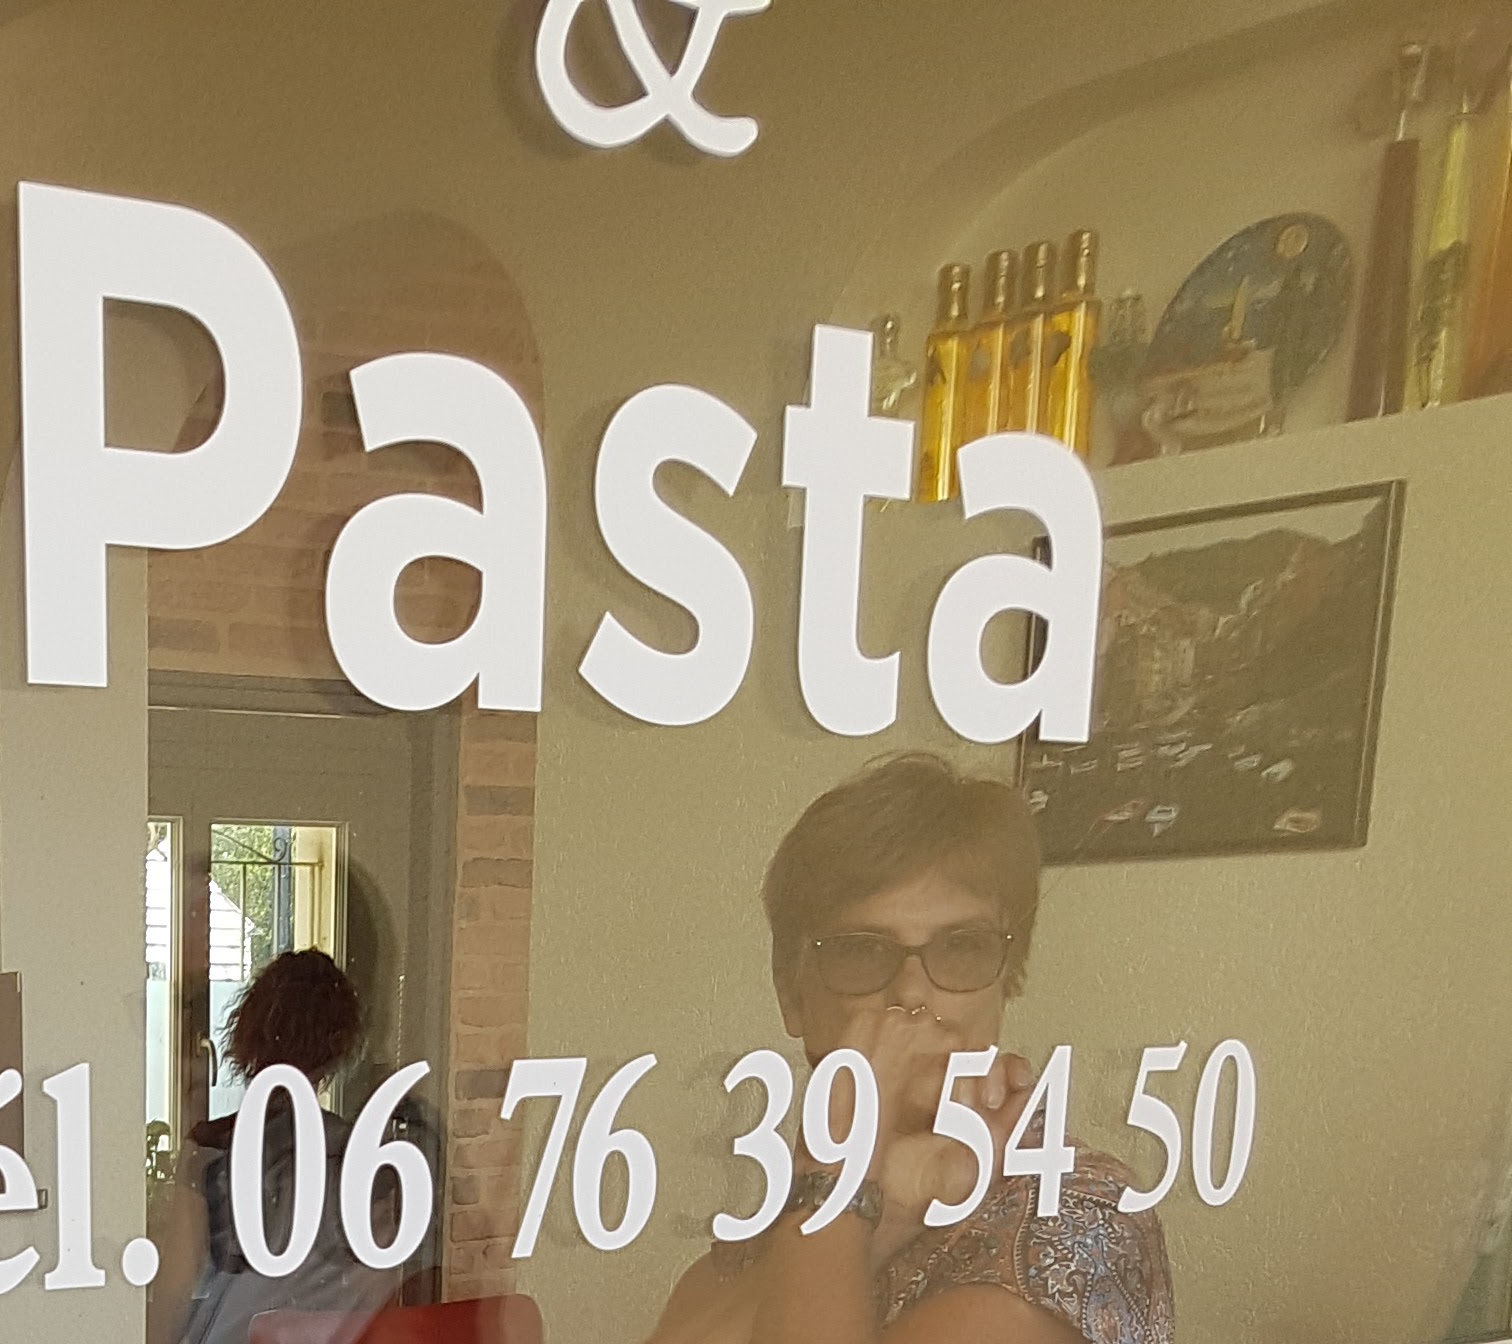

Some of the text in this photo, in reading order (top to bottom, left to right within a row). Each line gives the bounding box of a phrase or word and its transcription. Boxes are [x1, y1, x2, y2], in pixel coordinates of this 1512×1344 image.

[535, 0, 772, 157] &
[18, 181, 1105, 744] Pasta
[229, 1060, 433, 1278] 06
[500, 1053, 658, 1259] 76
[712, 1048, 879, 1241] 39
[923, 1044, 1076, 1227] 54
[1117, 1039, 1257, 1213] 50
